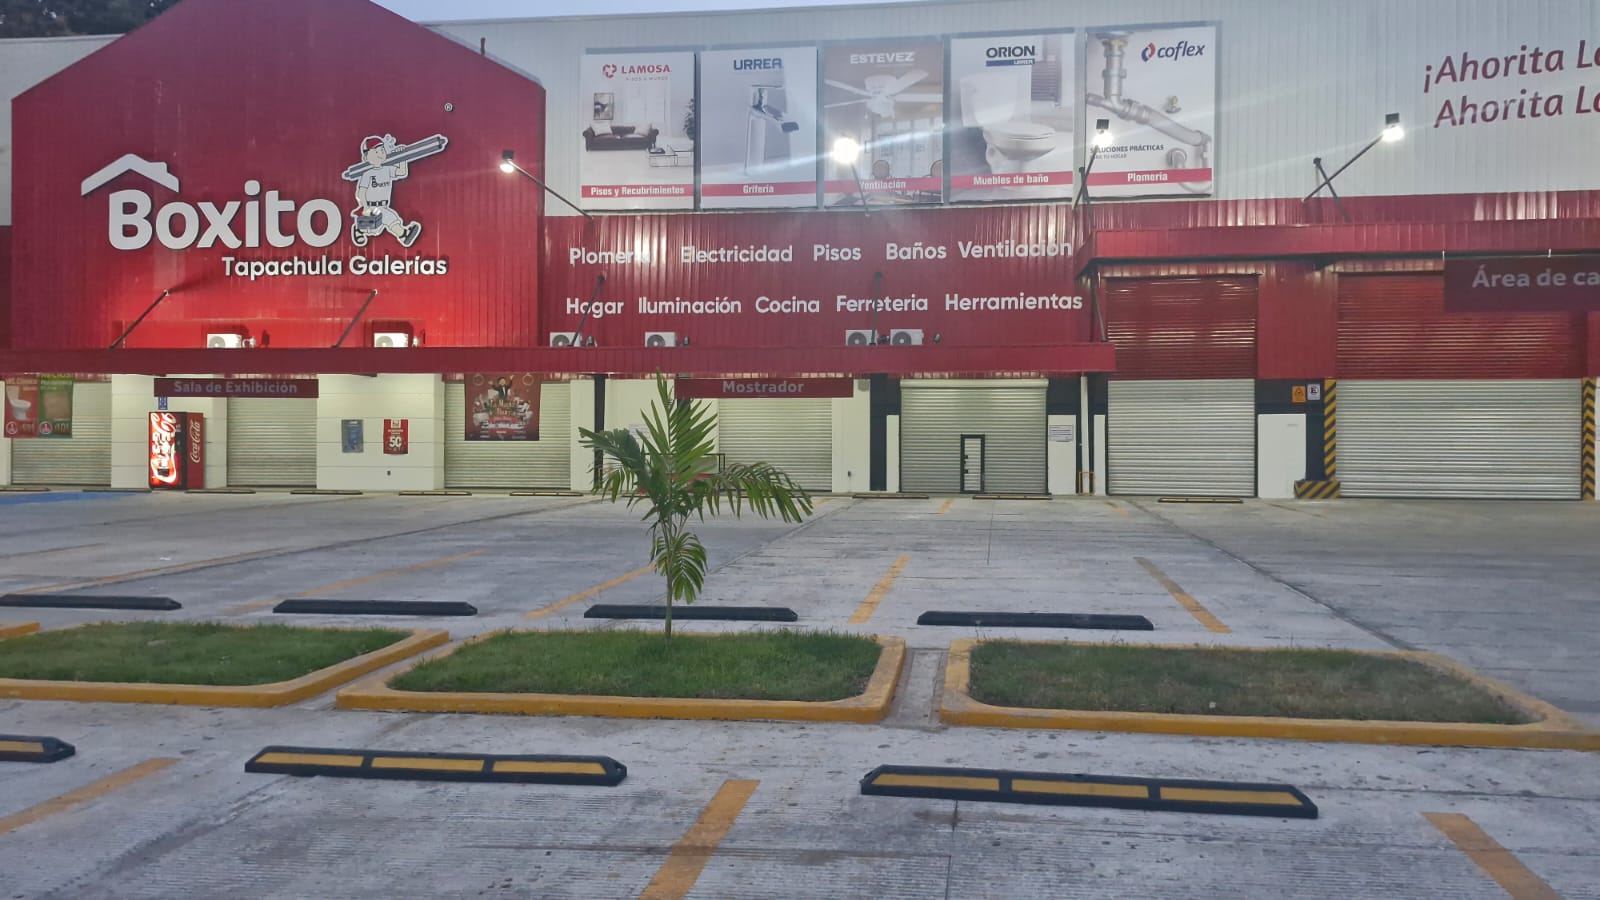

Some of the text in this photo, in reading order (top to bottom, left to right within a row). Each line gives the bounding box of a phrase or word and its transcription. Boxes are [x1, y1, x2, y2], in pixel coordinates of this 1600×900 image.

[850, 51, 915, 64] ESTEVEZ
[986, 46, 1035, 58] ORION
[1157, 41, 1205, 61] coflex
[621, 64, 671, 74] LAMOSA
[733, 58, 782, 70] URREA
[1424, 45, 1564, 93] ¡Ahorita
[1434, 89, 1563, 128] Ahorita
[973, 174, 1049, 185] Muebles de baño
[1127, 172, 1168, 182] Plomería
[591, 186, 685, 196] Pisos y Recubrimientos
[108, 180, 342, 250] Boxito
[569, 239, 1073, 264] Plomera Electricidad Pisos Baños Ventilación
[222, 254, 448, 281] Tapachula Galerías
[1472, 263, 1530, 288] Área
[1536, 267, 1567, 286] de
[566, 297, 625, 319] Hogar
[638, 296, 742, 314] Iluminación
[755, 295, 820, 314] Cocina
[944, 292, 1083, 311] Herramientas
[174, 381, 297, 393] Sala de Exhibición
[722, 380, 804, 393] Mostrador
[389, 436, 402, 448] 50
